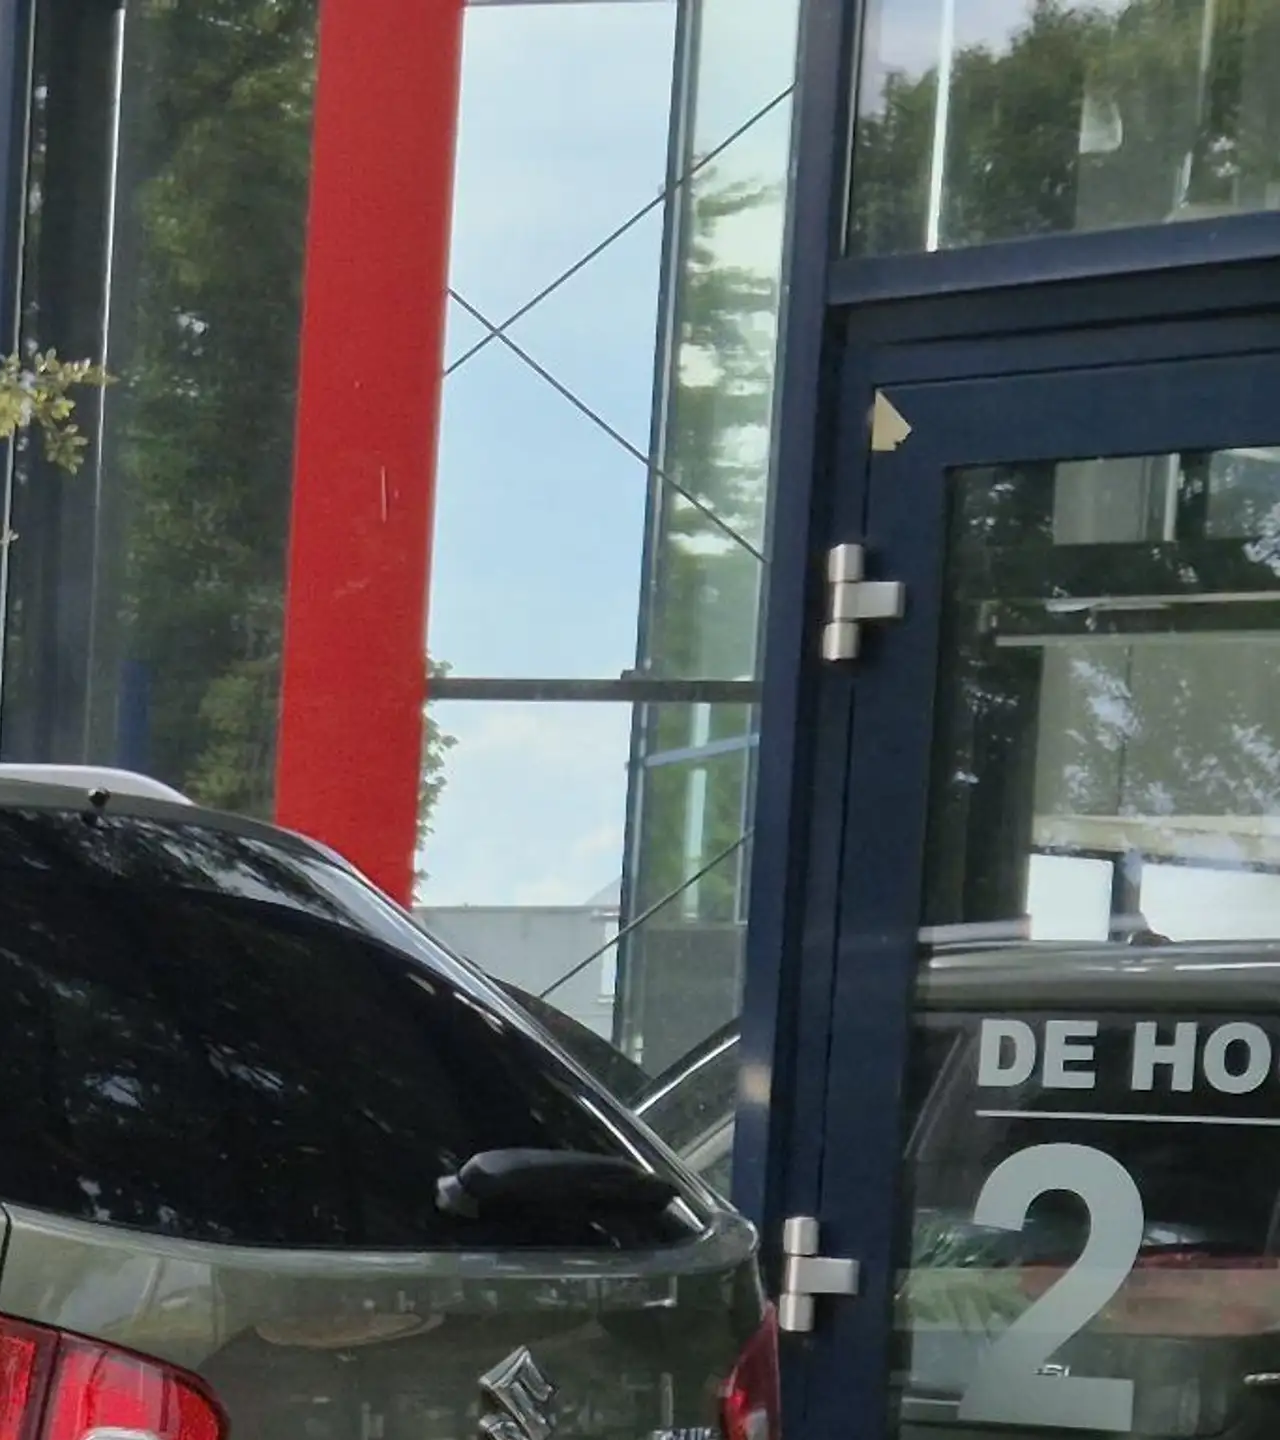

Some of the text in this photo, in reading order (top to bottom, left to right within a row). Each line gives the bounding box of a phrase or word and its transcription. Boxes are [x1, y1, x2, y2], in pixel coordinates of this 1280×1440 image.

[977, 1019, 1280, 1094] DE HO
[957, 1142, 1145, 1432] 2
